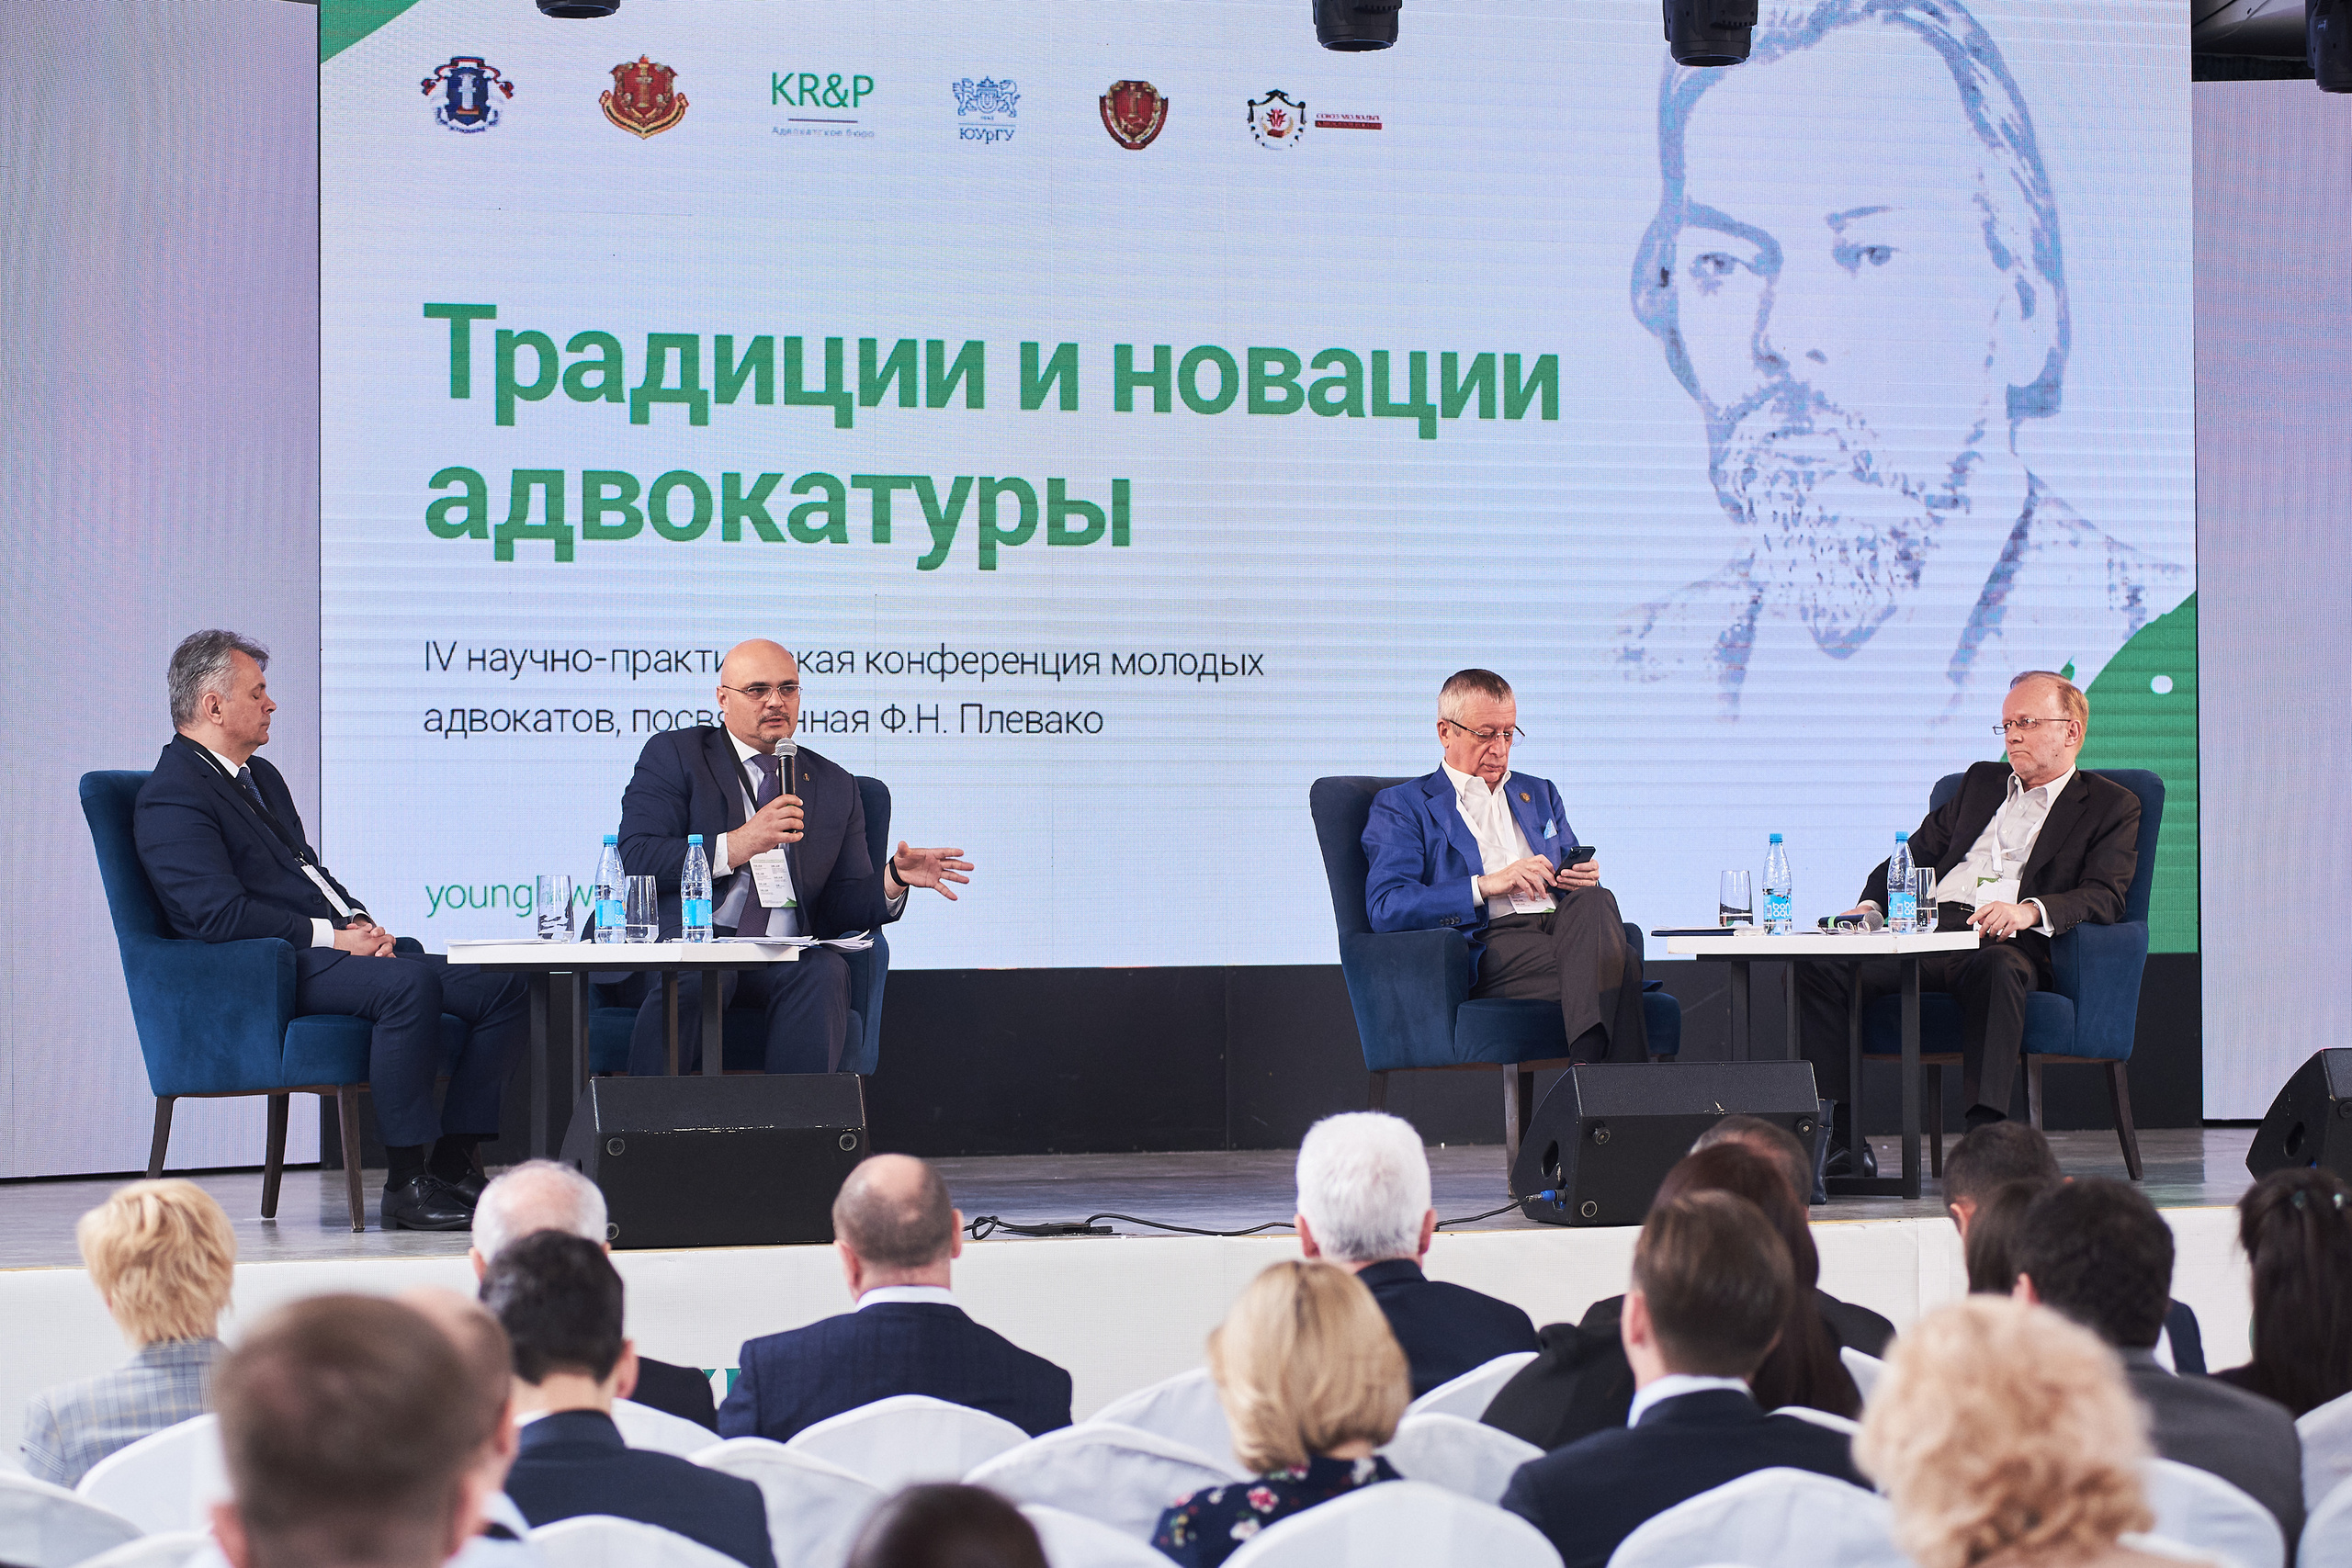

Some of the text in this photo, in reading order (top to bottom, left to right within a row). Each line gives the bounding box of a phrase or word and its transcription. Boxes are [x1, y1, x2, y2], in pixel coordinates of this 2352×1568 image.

[772, 72, 875, 108] KR&P
[959, 127, 1015, 145] ЮУрГУ
[423, 302, 1560, 440] Традиции и новации
[425, 466, 1132, 570] адвокатуры
[425, 641, 458, 671] IV
[866, 643, 1100, 682] конференция
[1113, 651, 1264, 683] молодых
[424, 707, 621, 739] адвокатов,
[880, 704, 947, 734] Ф.Н.
[961, 704, 1103, 734] Плевако
[1772, 909, 1792, 918] aqu
